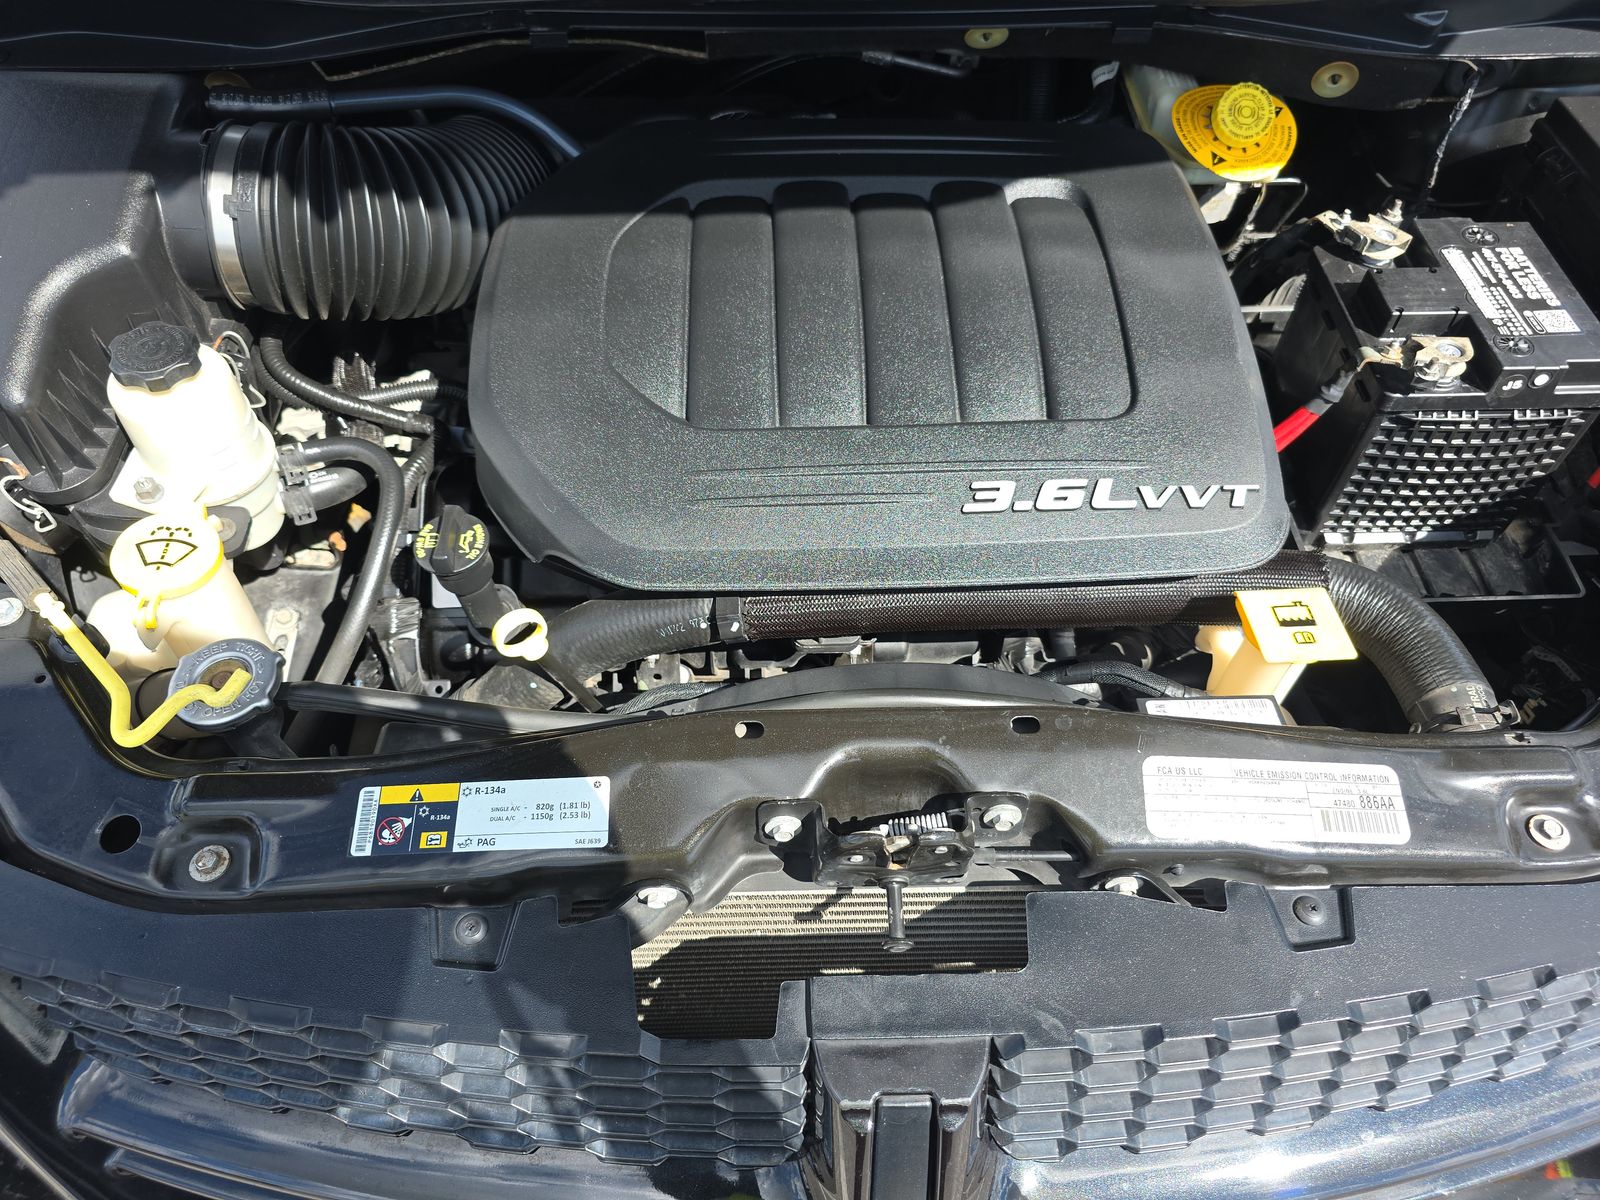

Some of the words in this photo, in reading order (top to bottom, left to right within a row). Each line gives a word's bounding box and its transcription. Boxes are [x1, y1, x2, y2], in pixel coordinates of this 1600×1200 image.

[1495, 247, 1523, 270] FOR
[1511, 271, 1542, 299] LESS
[1507, 247, 1562, 306] BATTERIES
[961, 478, 1137, 513] 3.6L
[1138, 484, 1260, 510] VVT
[465, 549, 480, 560] OIL
[200, 701, 242, 717] OPEN
[1157, 766, 1173, 775] FCA
[1175, 767, 1187, 775] US
[1189, 767, 1203, 776] LLC
[1233, 769, 1265, 779] VEHICLE
[1266, 770, 1303, 780] EMISSION
[1304, 772, 1338, 782] CONTROL
[1340, 774, 1390, 784] INFORMATION
[474, 786, 506, 795] R-134a
[535, 803, 554, 811] 820g
[559, 802, 578, 811] (1.81
[580, 801, 591, 811] lb)
[1359, 796, 1396, 810] 886AA
[530, 813, 554, 822] 1150g
[559, 812, 579, 820] (2.53
[580, 811, 591, 820] lb)
[477, 838, 496, 847] PAG
